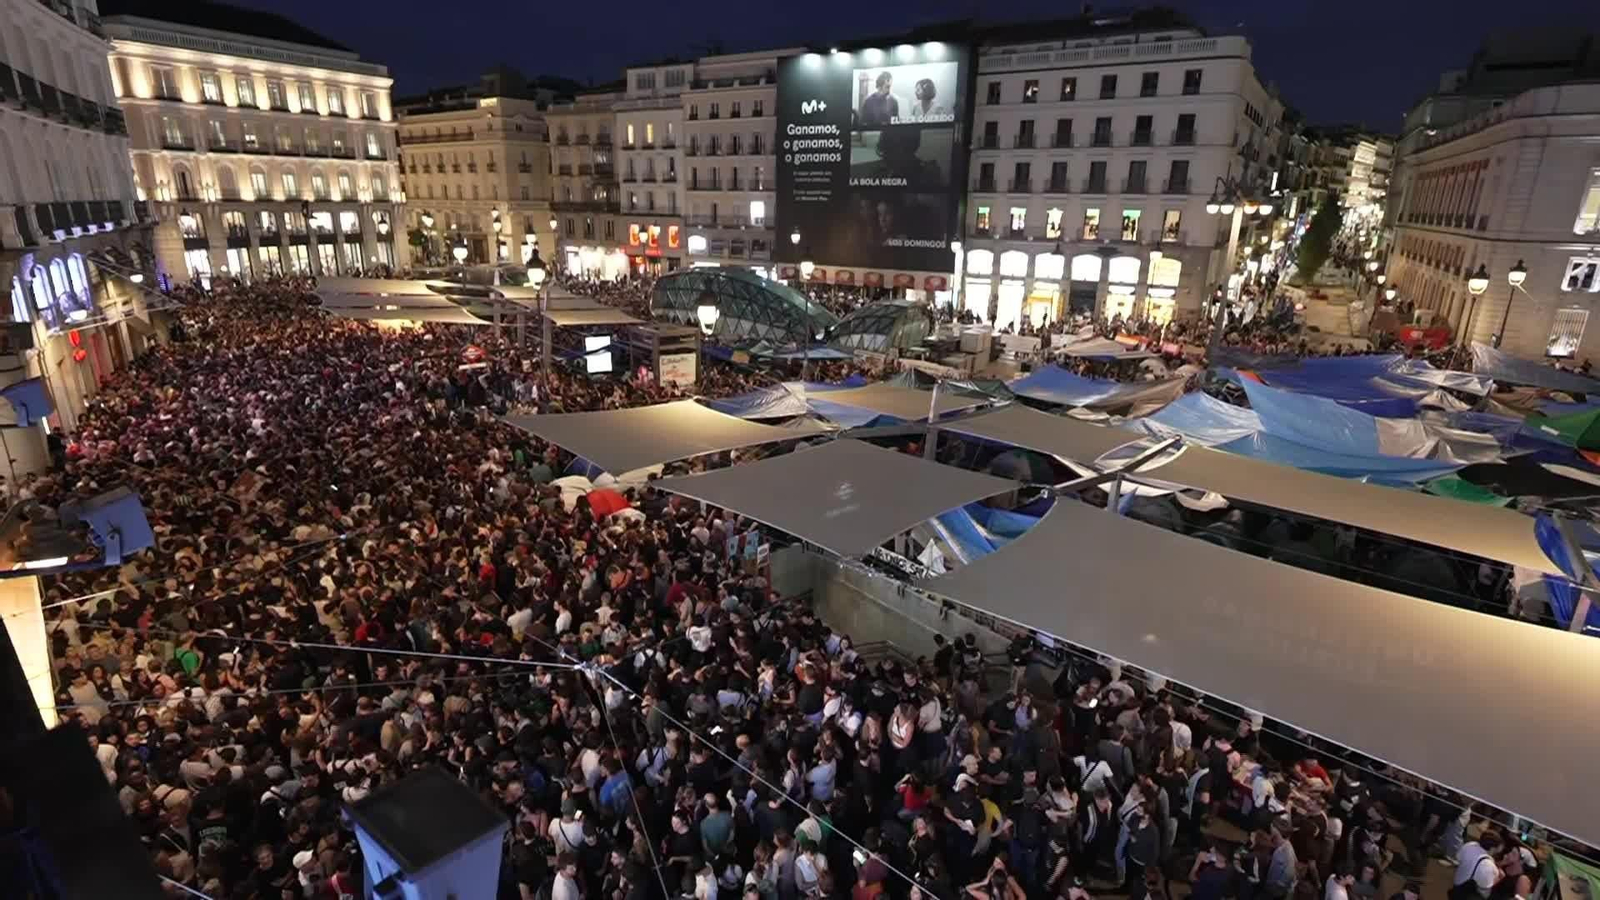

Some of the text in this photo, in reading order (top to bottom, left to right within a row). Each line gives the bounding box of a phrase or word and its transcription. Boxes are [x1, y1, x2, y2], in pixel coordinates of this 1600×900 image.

[787, 123, 840, 136] Ganamos,
[783, 138, 843, 152] o ganamos,
[785, 152, 842, 165] o ganamos
[849, 178, 907, 186] LA BOLA NEGRA
[904, 239, 946, 249] DOMINGOS
